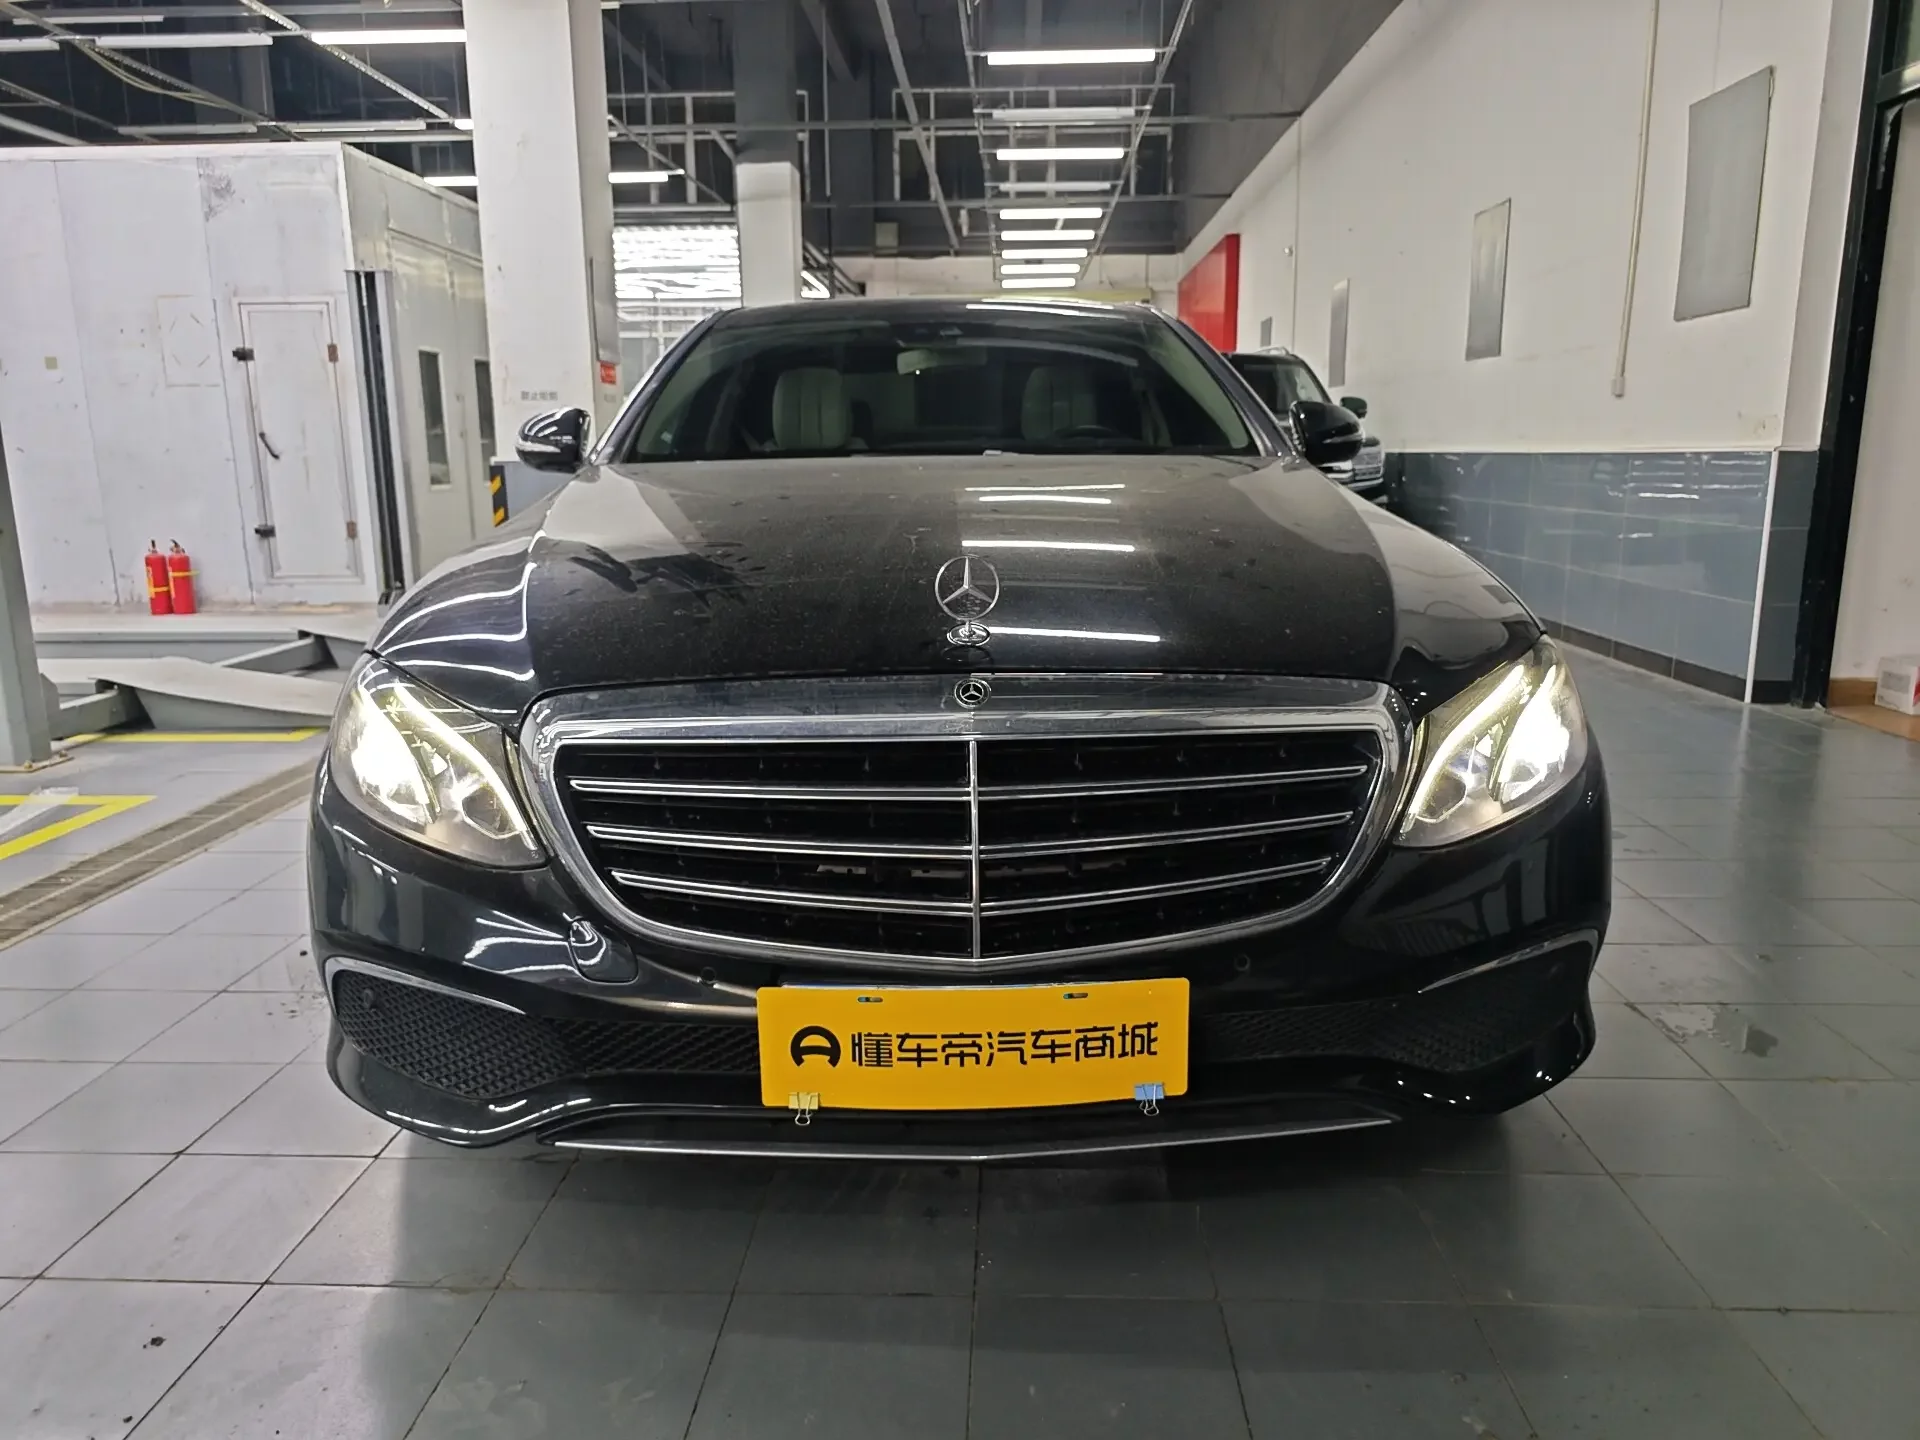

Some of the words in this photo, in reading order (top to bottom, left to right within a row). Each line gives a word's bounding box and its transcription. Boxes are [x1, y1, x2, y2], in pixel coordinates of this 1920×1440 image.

[851, 1021, 1159, 1068] 懂车帝汽车商城
